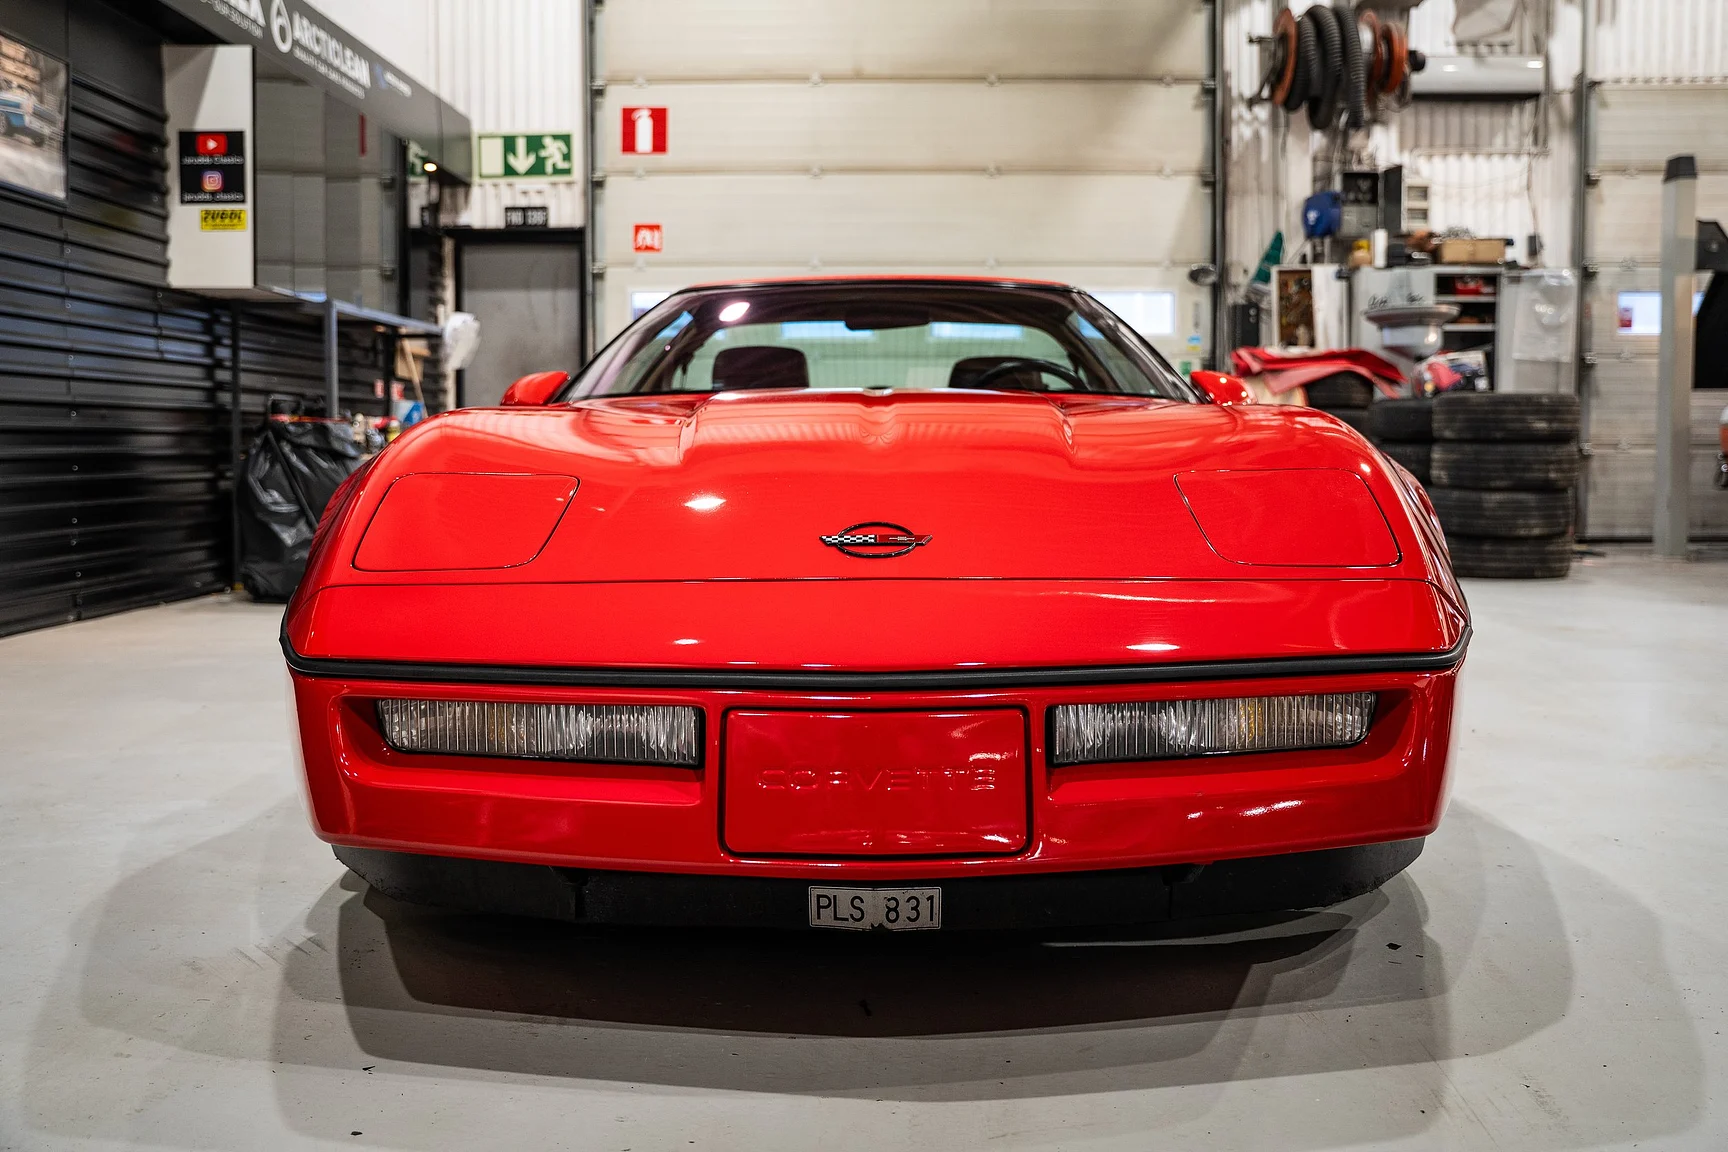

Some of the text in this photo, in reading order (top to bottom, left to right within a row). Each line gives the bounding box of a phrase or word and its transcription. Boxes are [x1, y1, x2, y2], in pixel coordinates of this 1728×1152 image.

[292, 10, 371, 89] ARCTICLEAN
[758, 769, 996, 792] CORVETTE
[815, 893, 935, 924] PLS 831
